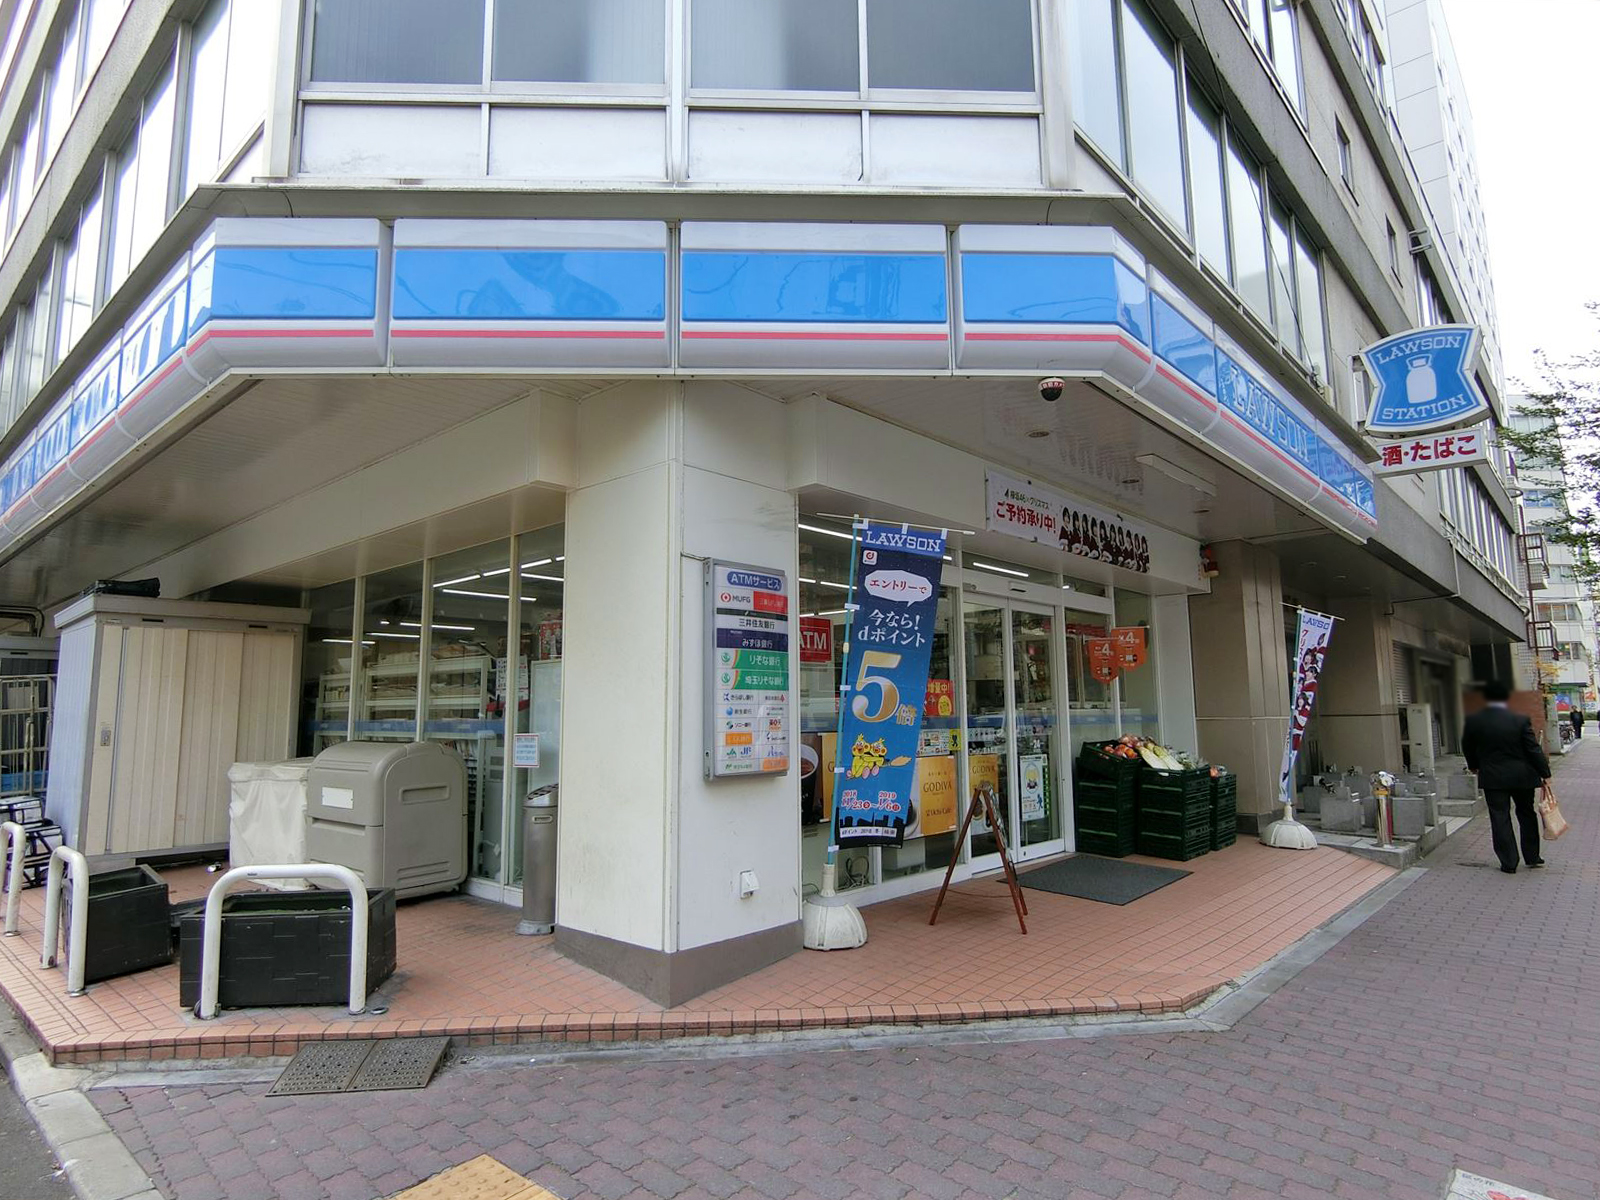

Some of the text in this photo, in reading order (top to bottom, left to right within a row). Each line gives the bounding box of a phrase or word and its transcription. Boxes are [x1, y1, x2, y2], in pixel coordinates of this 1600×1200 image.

[1376, 335, 1462, 364] LAWSON
[1231, 365, 1309, 461] LAWSON
[1382, 394, 1468, 420] STATION
[865, 530, 941, 552] LAWSON
[731, 573, 780, 590] ATMサービス
[870, 579, 927, 594] エントリーで
[732, 595, 751, 603] MUFG
[739, 618, 775, 629] 三井住友銀行
[742, 638, 773, 648] みずほ銀行
[858, 625, 925, 648] dポイント
[750, 655, 780, 666] りそな銀行
[923, 781, 952, 793] GODIVA
